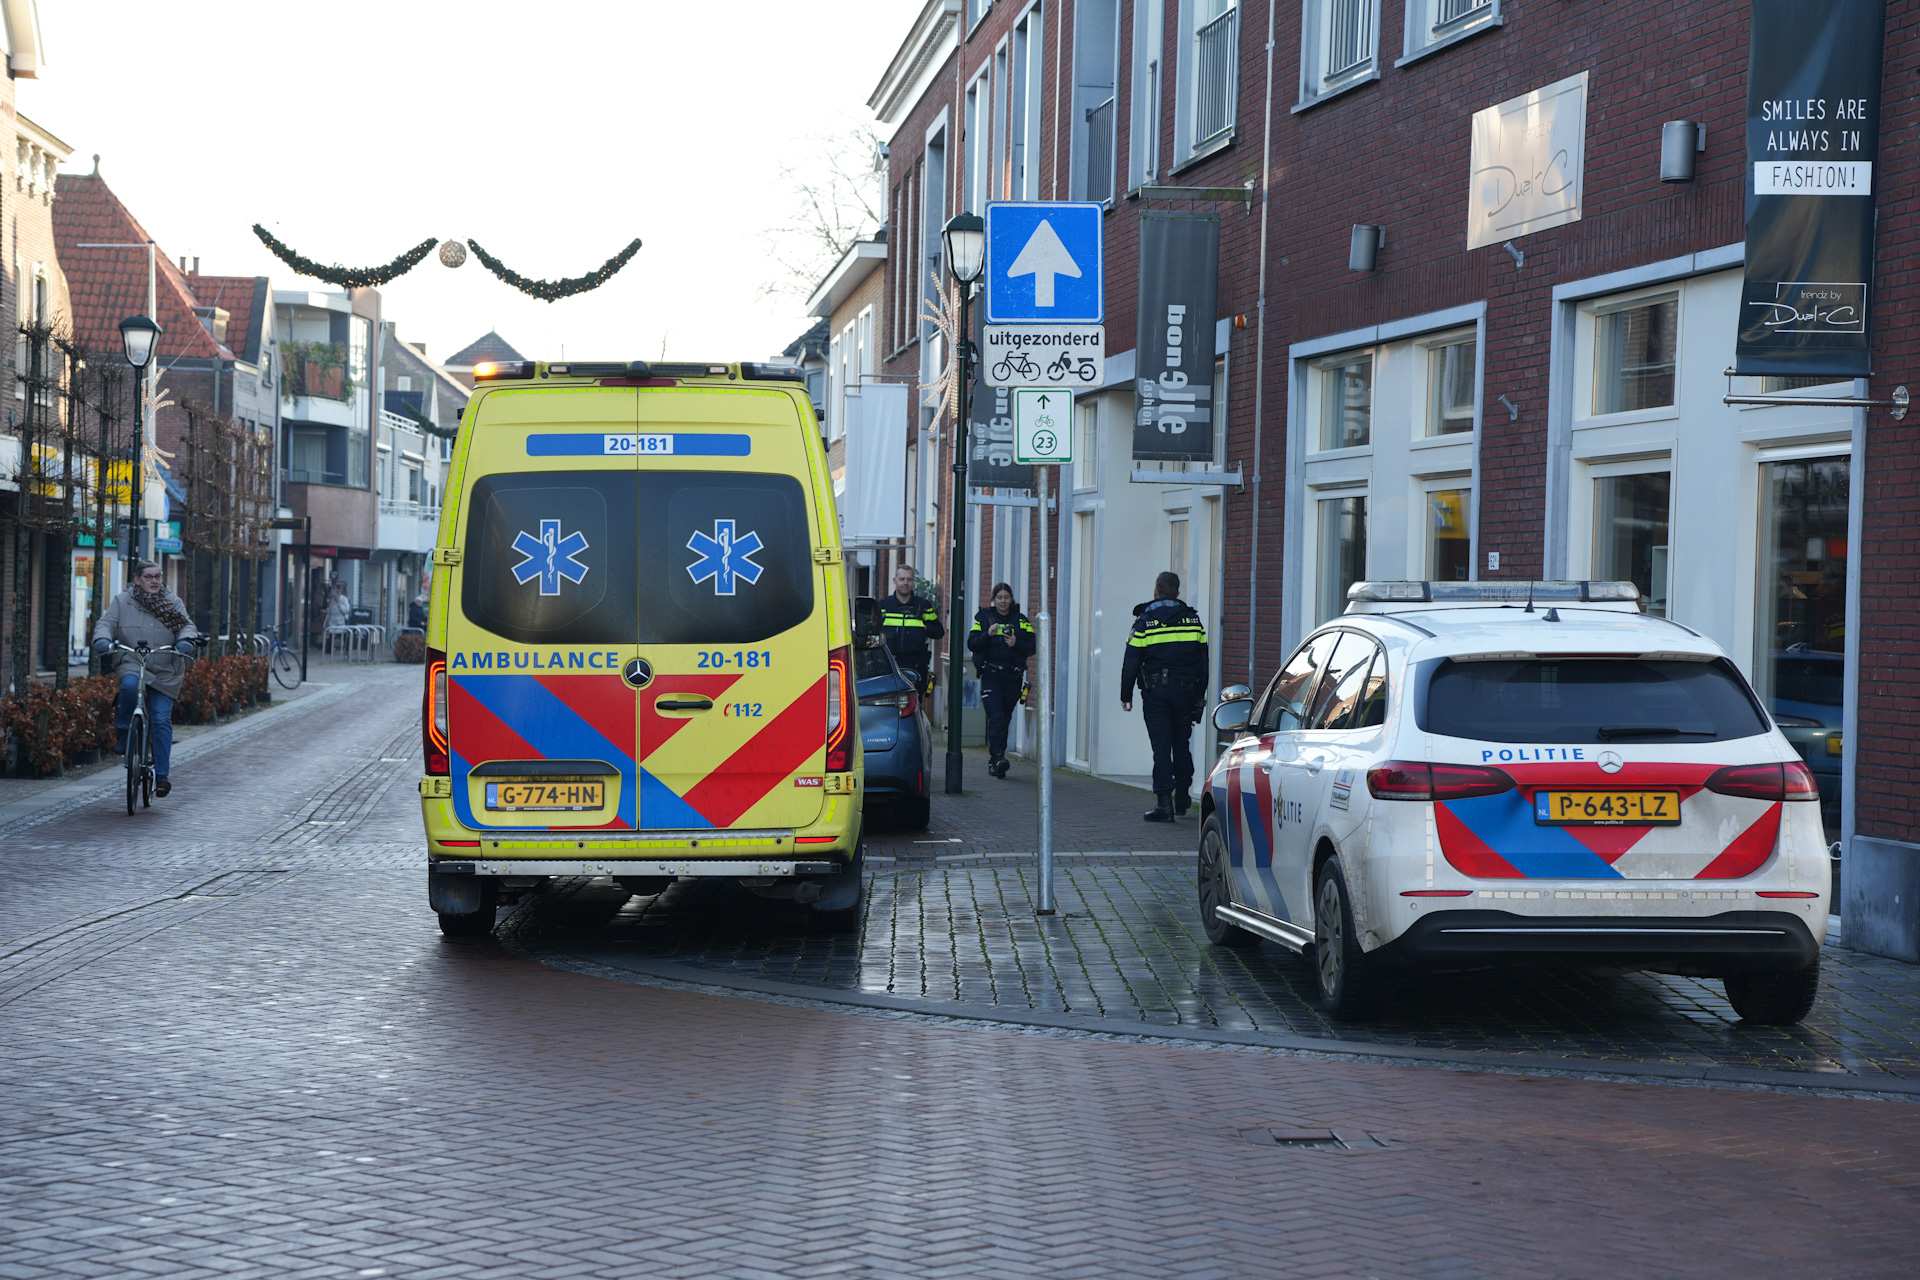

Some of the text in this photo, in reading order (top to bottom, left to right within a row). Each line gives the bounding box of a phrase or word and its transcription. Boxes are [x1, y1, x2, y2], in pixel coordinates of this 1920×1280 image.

[1762, 98, 1867, 121] SMILES ARE
[1767, 129, 1860, 151] ALWAYS IN
[1474, 148, 1573, 218] Dual-C
[1772, 166, 1856, 188] FASHION!
[1801, 290, 1842, 301] trendz by
[1748, 301, 1860, 326] Dual-C
[989, 331, 1100, 349] uitgezonderd
[1142, 379, 1156, 426] fashion
[608, 437, 669, 451] 20-181
[976, 423, 987, 461] fashion
[1035, 436, 1054, 449] 23
[451, 651, 619, 669] AMBULANCE
[697, 650, 771, 669] 20-181
[1481, 747, 1586, 763] POLITIE
[503, 786, 595, 804] G-774-HN
[1560, 796, 1668, 817] P-643-LZ
